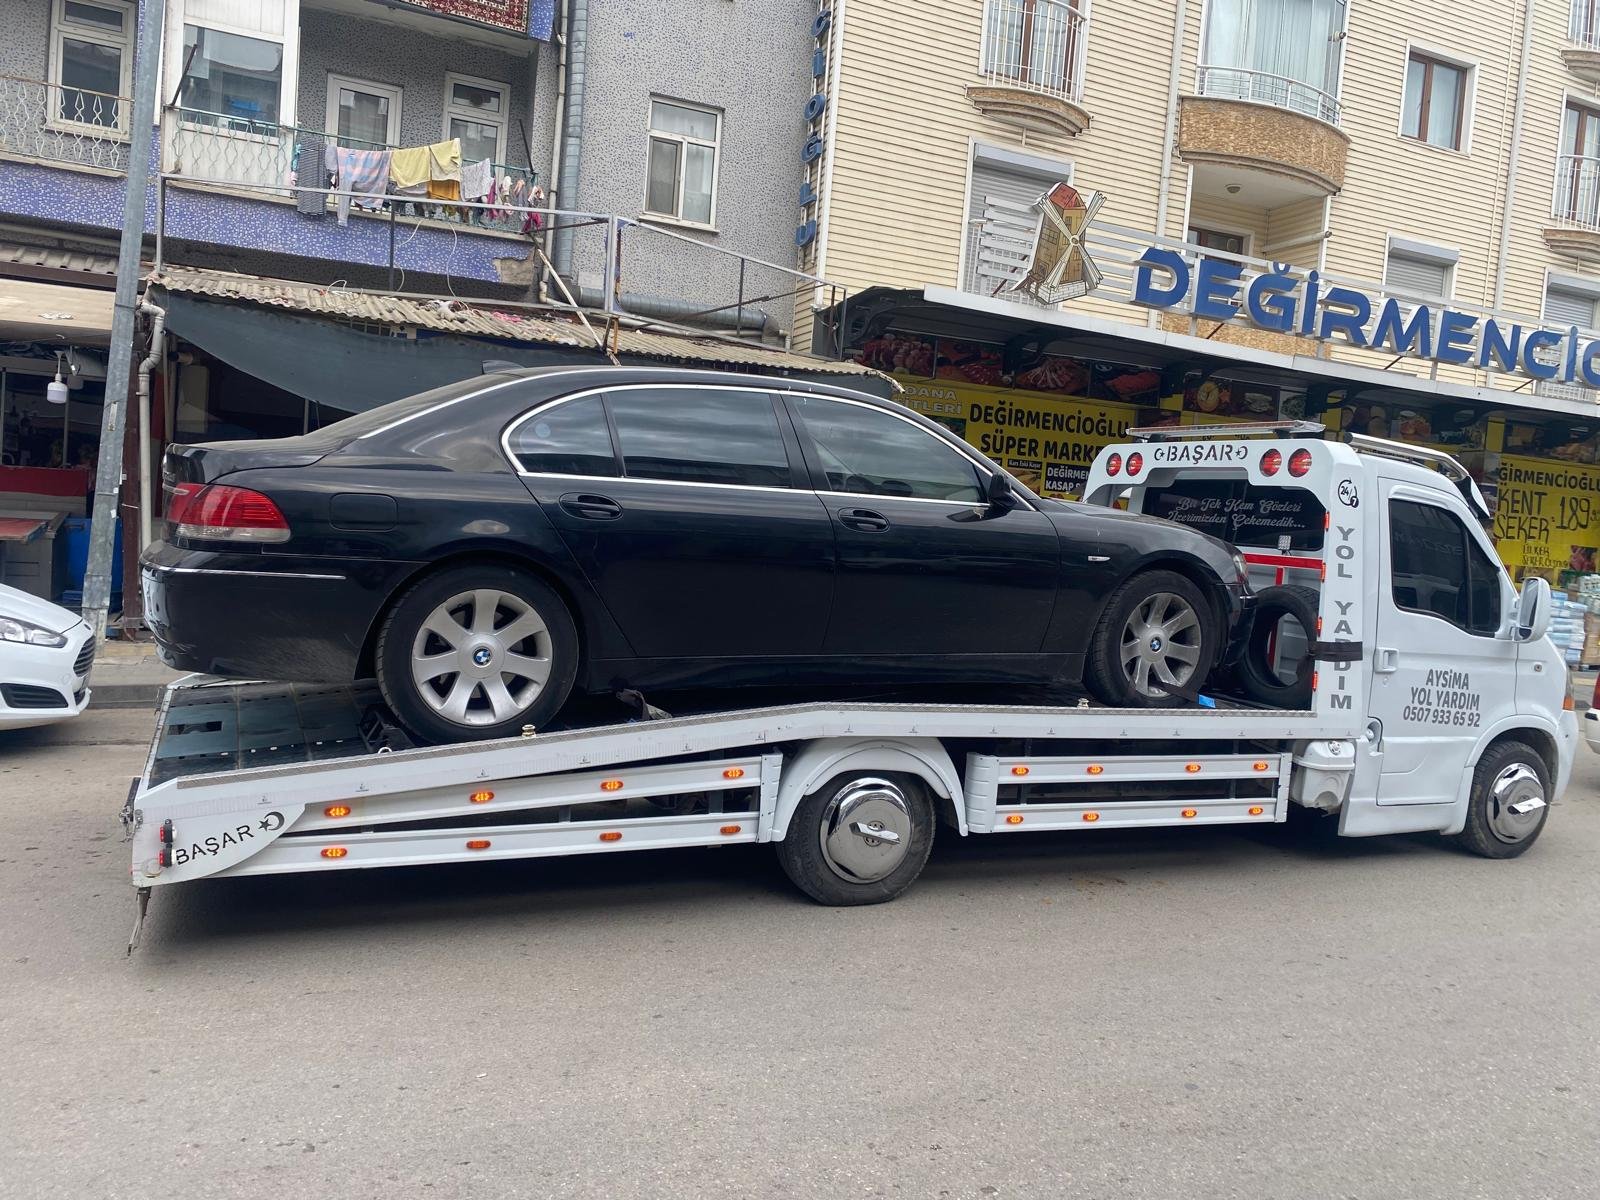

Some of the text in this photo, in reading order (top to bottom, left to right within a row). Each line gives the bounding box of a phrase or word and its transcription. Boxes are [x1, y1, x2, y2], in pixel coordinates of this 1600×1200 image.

[969, 400, 1130, 439] DEĞİRMENCİOĞLU
[980, 428, 1039, 458] SÜPER
[1166, 444, 1234, 465] BAŞAR
[1045, 480, 1074, 492] KASAP
[1201, 498, 1222, 511] Tek
[1224, 498, 1254, 512] Kem
[1259, 499, 1303, 514] Gözleri
[1497, 488, 1547, 517] KENT
[1556, 496, 1590, 531] 189
[1330, 525, 1356, 710] YOL YADIM
[1411, 687, 1480, 711] YOL YARDIM
[1403, 705, 1481, 728] 0507 933 65 92
[176, 824, 255, 865] BAŞAR
